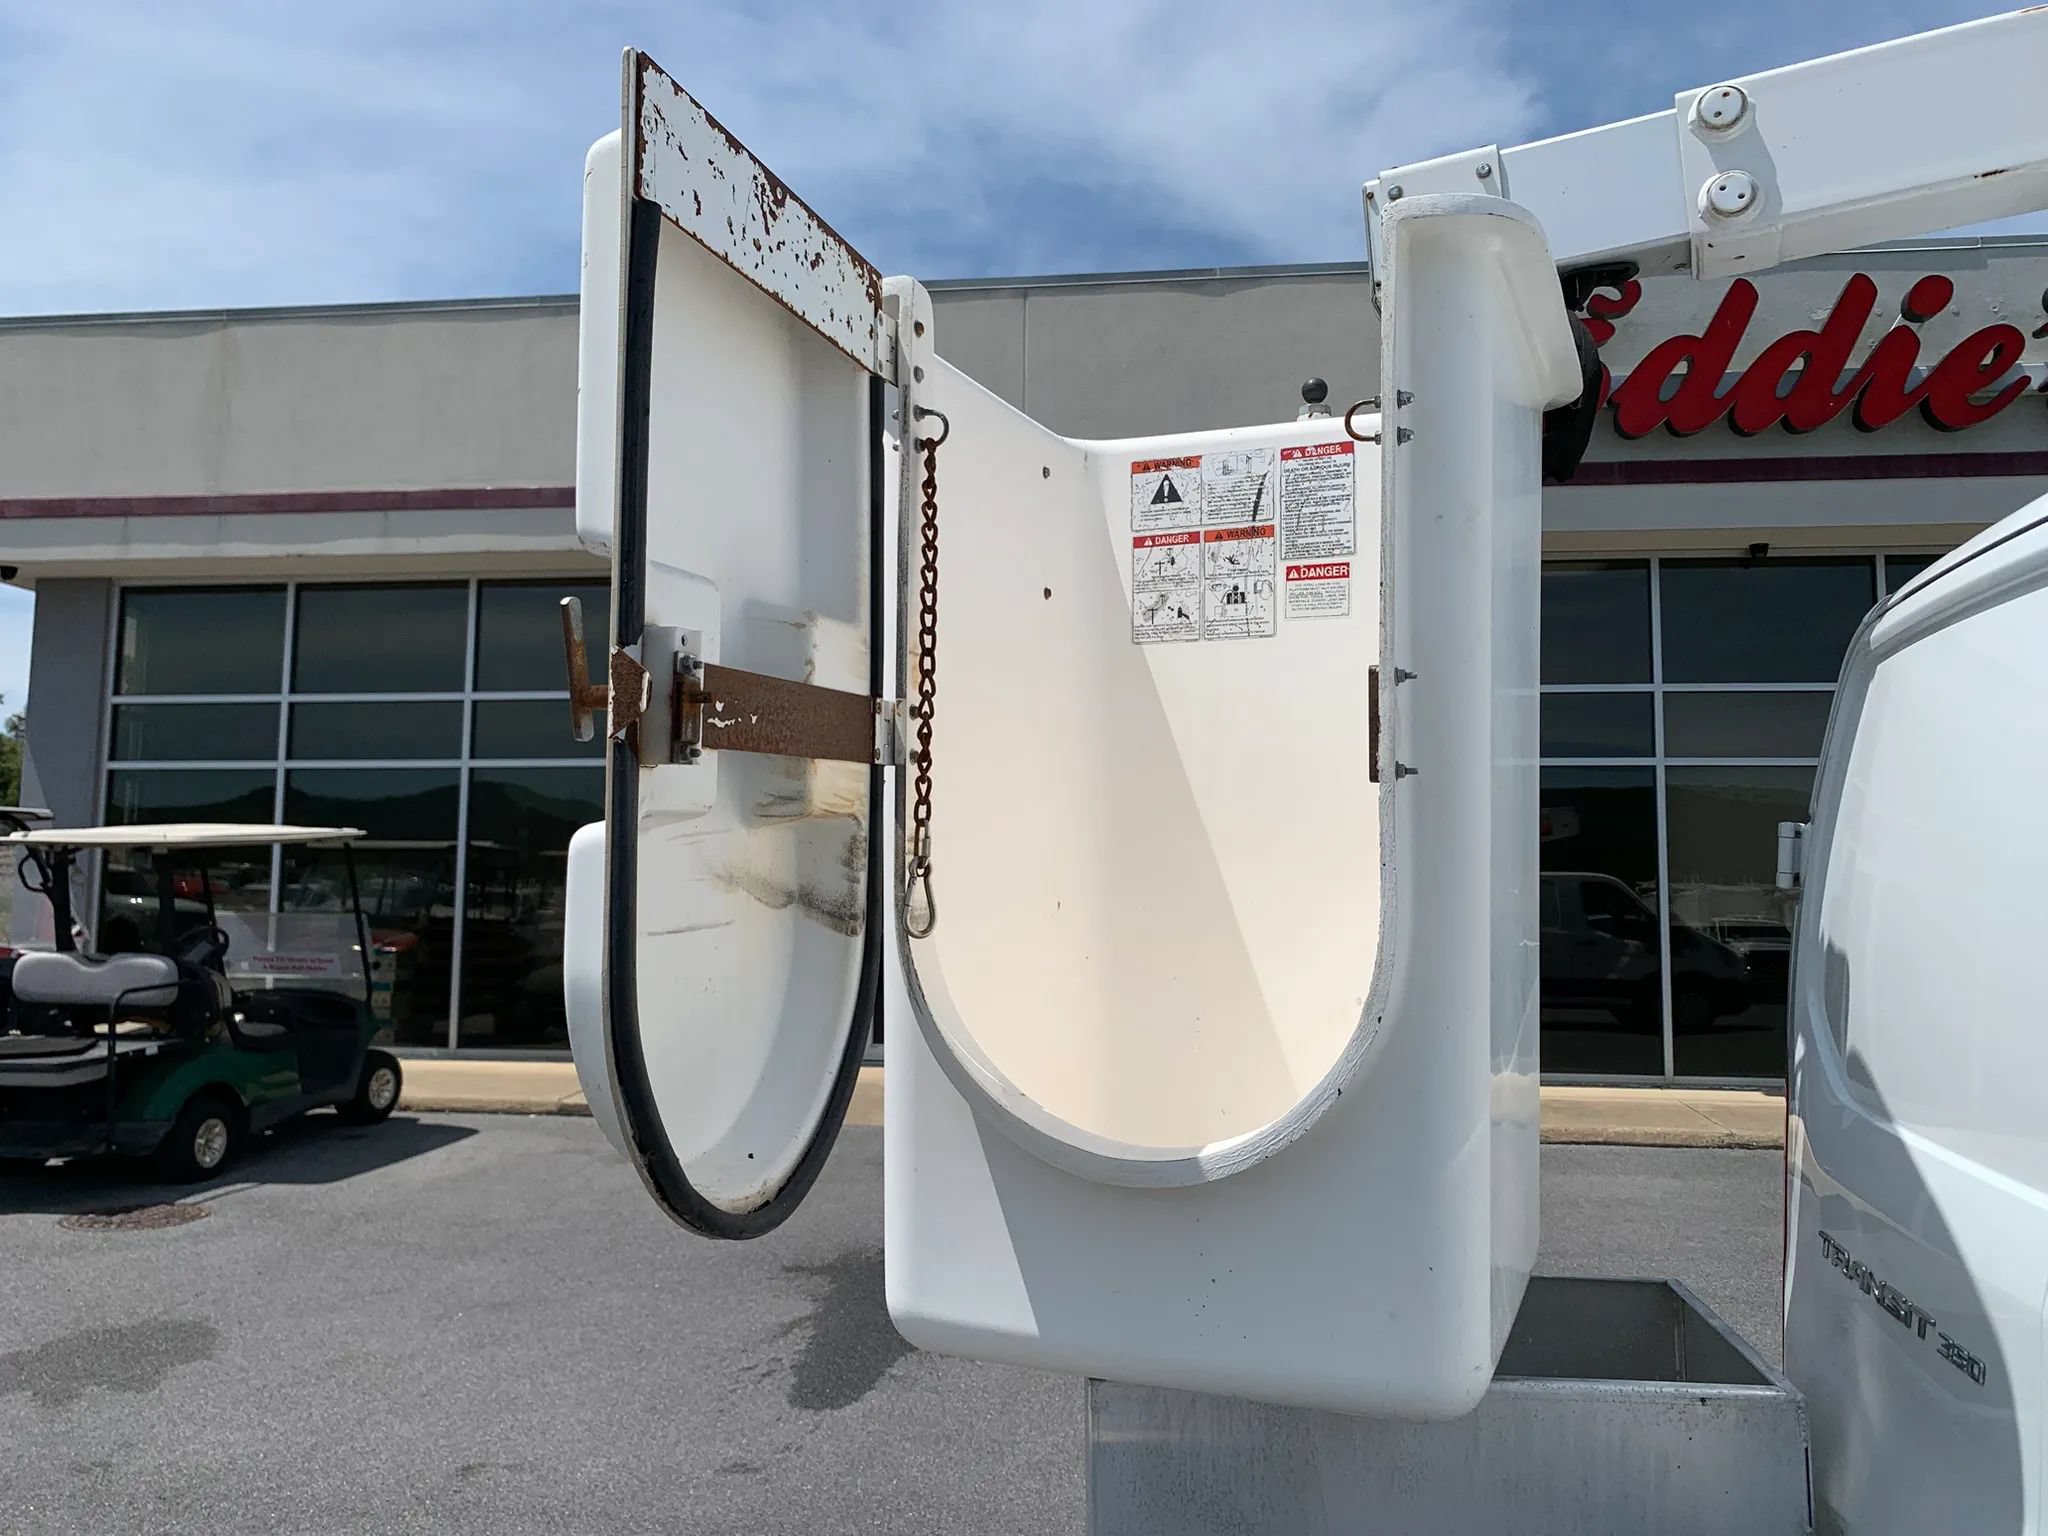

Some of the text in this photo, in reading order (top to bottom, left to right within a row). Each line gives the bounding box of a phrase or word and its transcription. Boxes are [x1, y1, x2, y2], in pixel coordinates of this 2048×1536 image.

[1578, 272, 2048, 439] ddie
[1305, 445, 1342, 456] DANGER
[1154, 458, 1192, 471] WARNING
[1155, 534, 1190, 545] DANGER
[1227, 527, 1266, 539] WARNING
[1300, 565, 1348, 578] DANGER
[1818, 1230, 1986, 1386] TRANSIT 350
